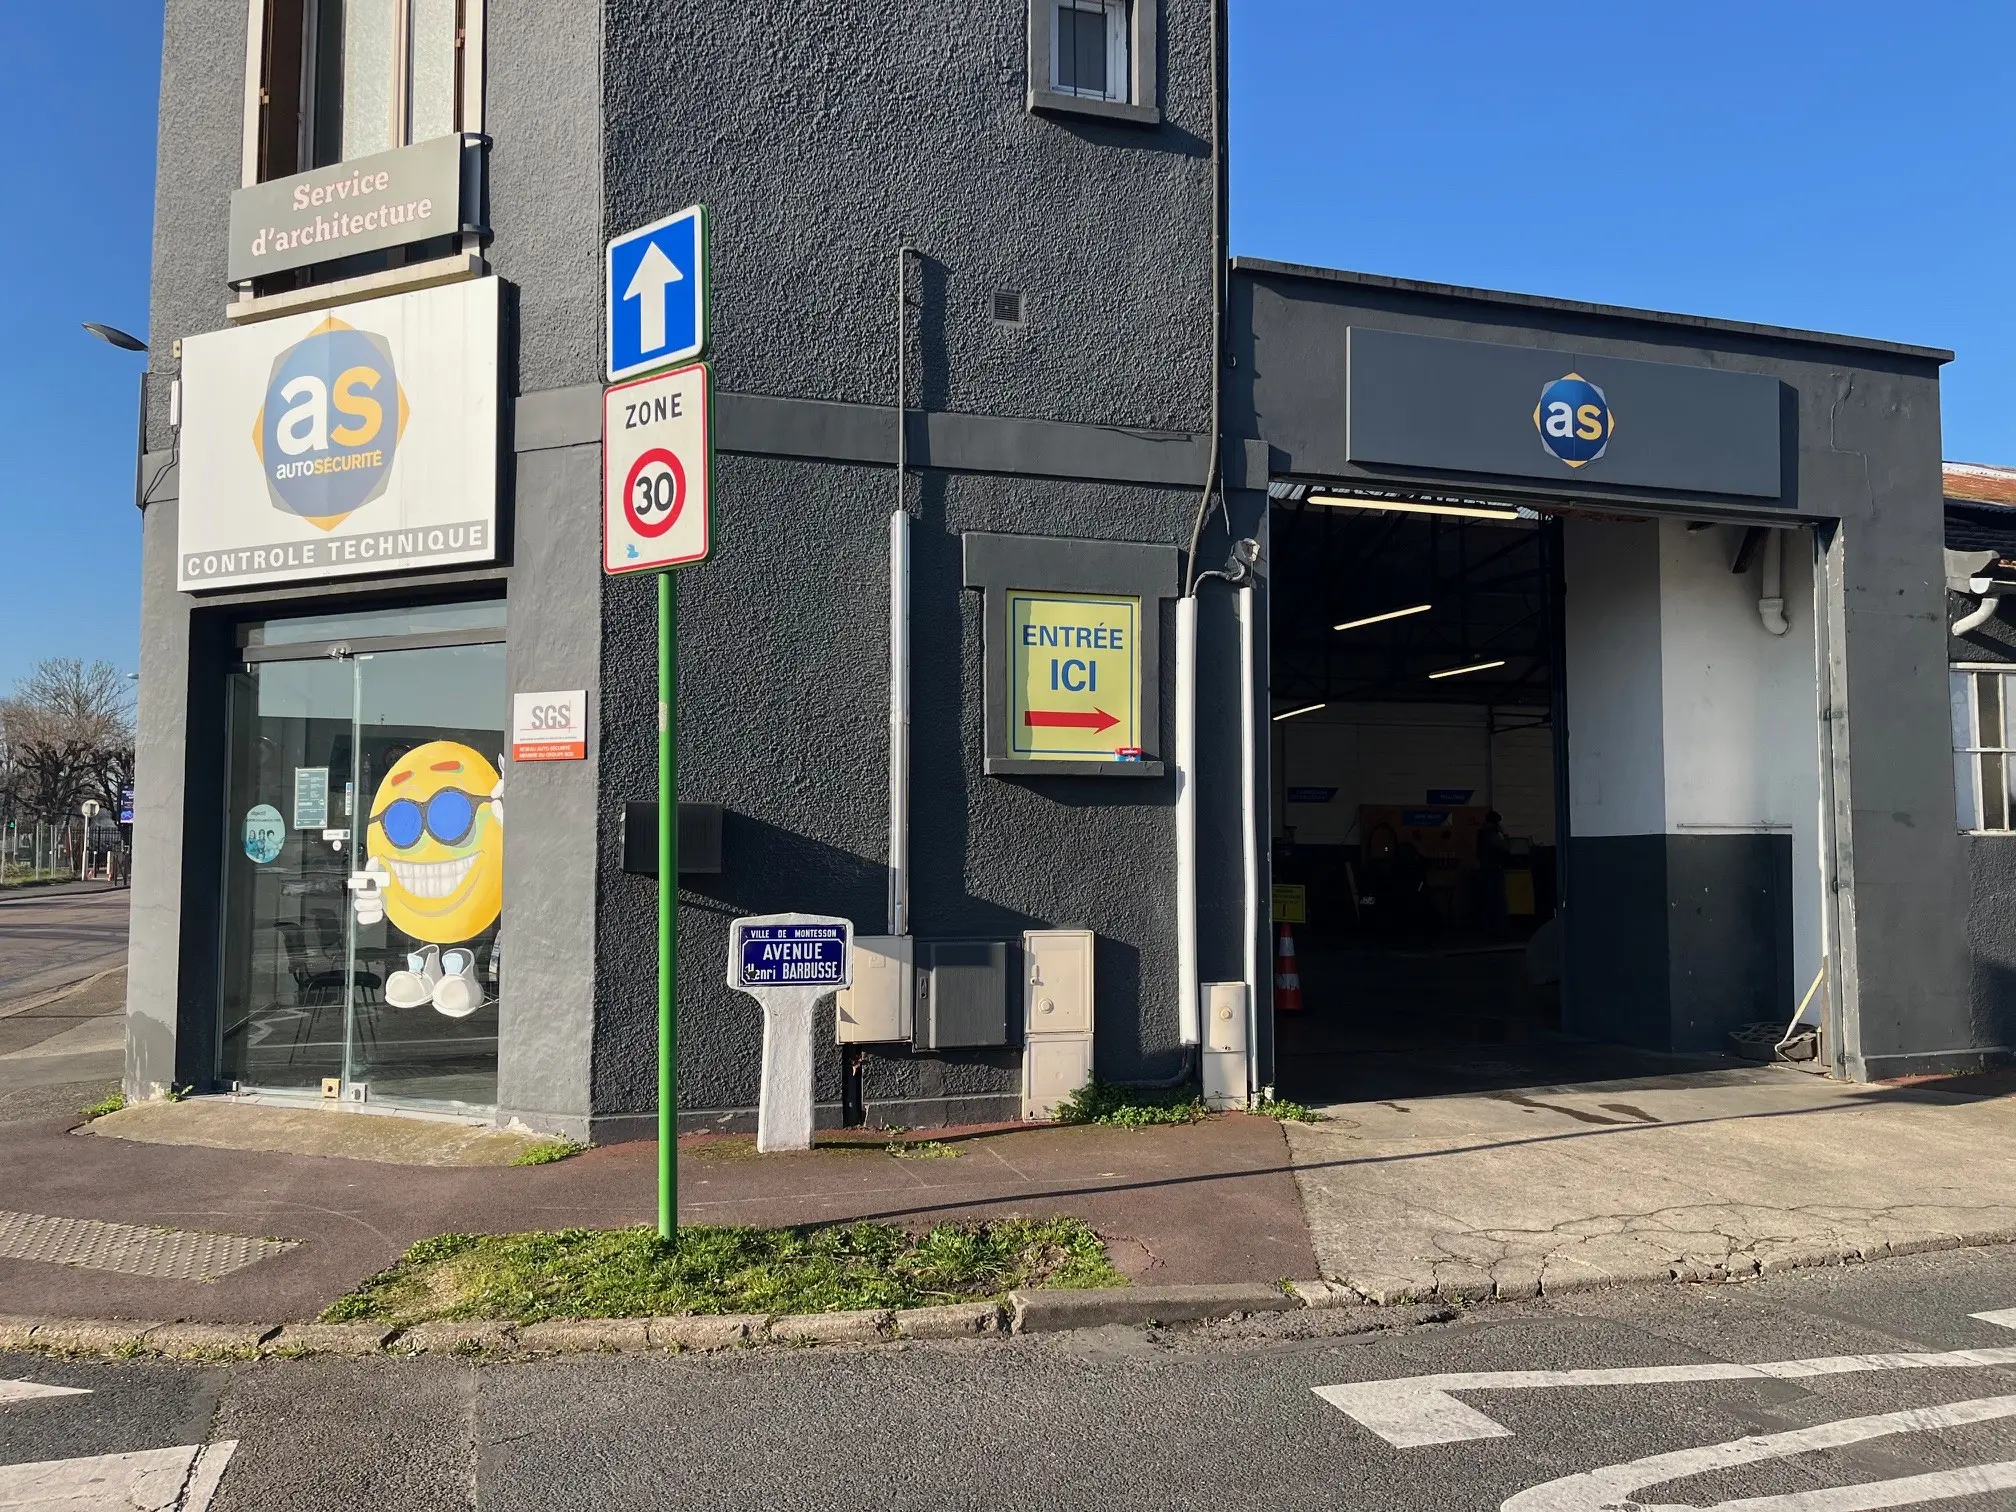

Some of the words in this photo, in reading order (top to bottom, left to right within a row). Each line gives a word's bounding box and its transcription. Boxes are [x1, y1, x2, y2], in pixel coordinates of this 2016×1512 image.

[292, 167, 390, 212] Service
[276, 366, 382, 456] as
[625, 393, 684, 429] ZONE
[1545, 401, 1603, 441] as
[635, 472, 675, 515] 30
[187, 543, 315, 575] CONTROLE
[328, 525, 482, 559] TECHNIQUE
[1022, 621, 1124, 650] ENTRÉE
[1050, 658, 1096, 692] ICI
[532, 705, 570, 728] SGS
[750, 930, 770, 938] VILLE
[777, 929, 787, 938] DE
[795, 929, 837, 938] MONTESSON
[762, 942, 823, 961] AVENUE
[782, 962, 838, 980] BARBUSSE
